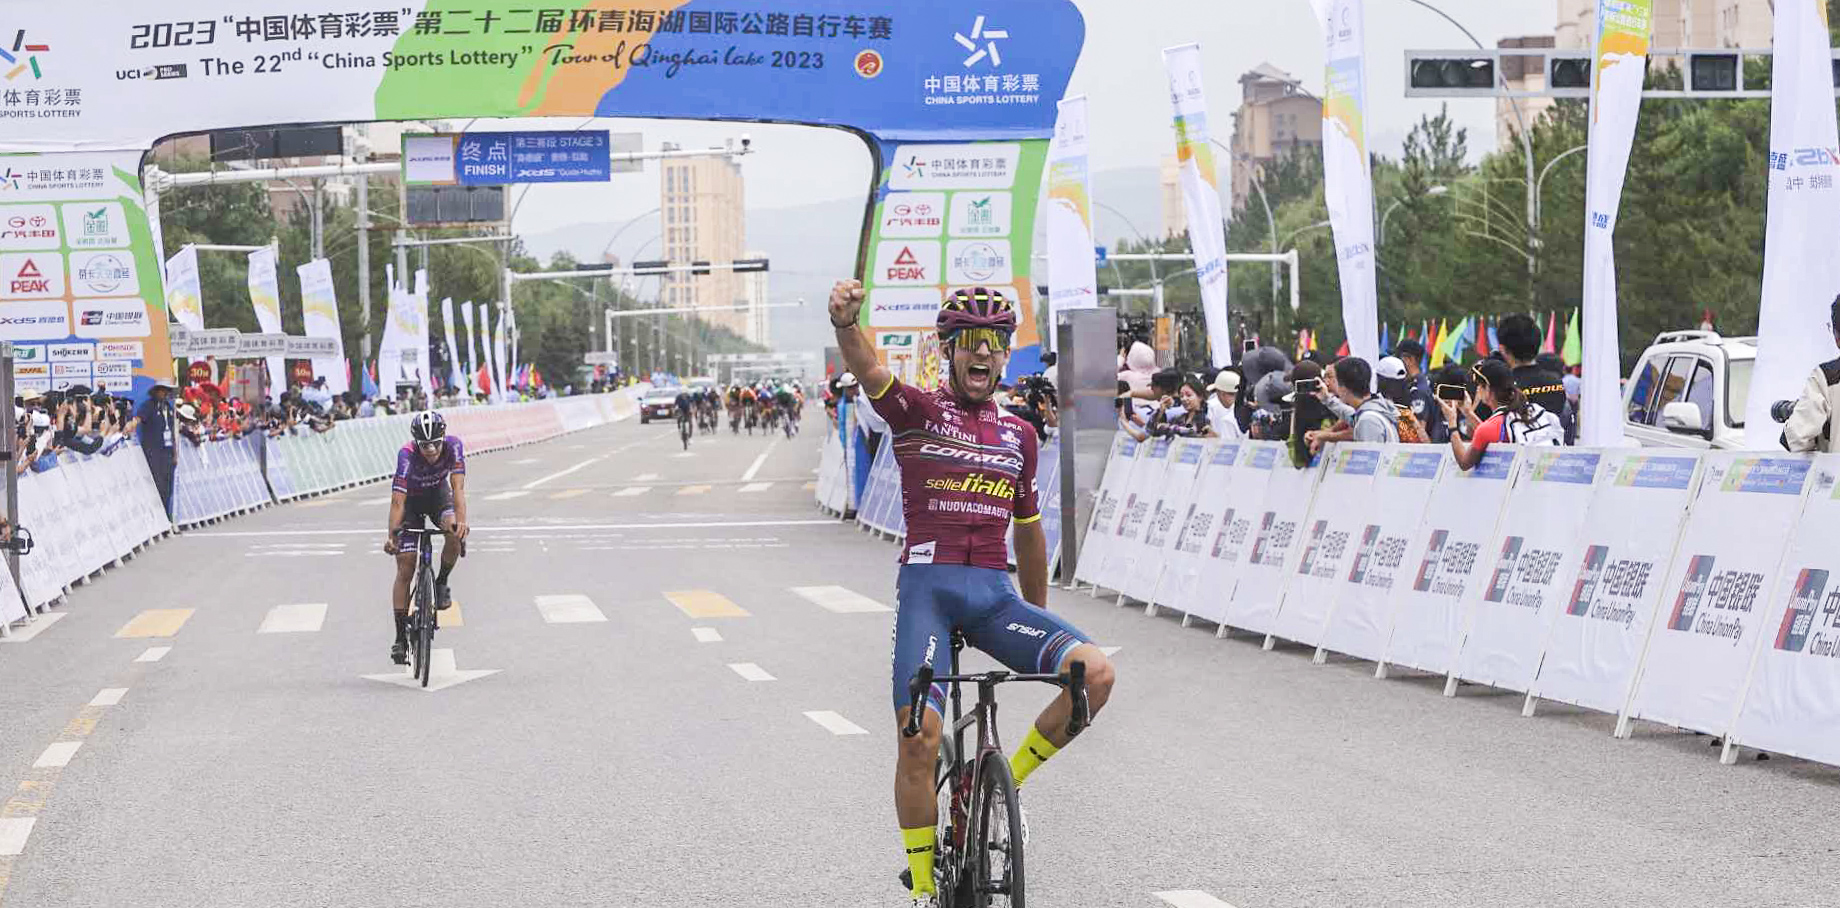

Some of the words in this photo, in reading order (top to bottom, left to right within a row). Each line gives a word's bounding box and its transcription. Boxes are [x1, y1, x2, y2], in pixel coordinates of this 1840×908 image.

[130, 21, 217, 49] 2023
[200, 58, 244, 76] The
[253, 48, 302, 73] 22nd
[382, 51, 444, 71] Sports
[544, 43, 598, 66] Tour
[602, 40, 625, 69] of
[628, 42, 718, 78] Qinghai
[771, 51, 824, 69] 2023
[115, 69, 140, 80] UCI
[924, 74, 1040, 93] 中国体育彩票
[0, 88, 82, 106] 体育彩票
[925, 95, 955, 104] CHINA
[956, 95, 995, 104] SPORTS
[996, 94, 1040, 103] LOTTERY
[38, 109, 81, 118] LOTTERY
[560, 136, 594, 147] STAGE
[462, 140, 507, 161] 终点
[464, 165, 506, 176] FINISH
[931, 158, 1006, 170] 中国体育彩票
[27, 168, 104, 182] 中国体育彩票
[887, 267, 926, 280] PEAK
[11, 279, 50, 293] PEAK
[925, 420, 977, 443] FANTINI
[920, 443, 1024, 472] corratec
[1602, 559, 1653, 599] 中国银联
[1708, 570, 1765, 613] 中国银联
